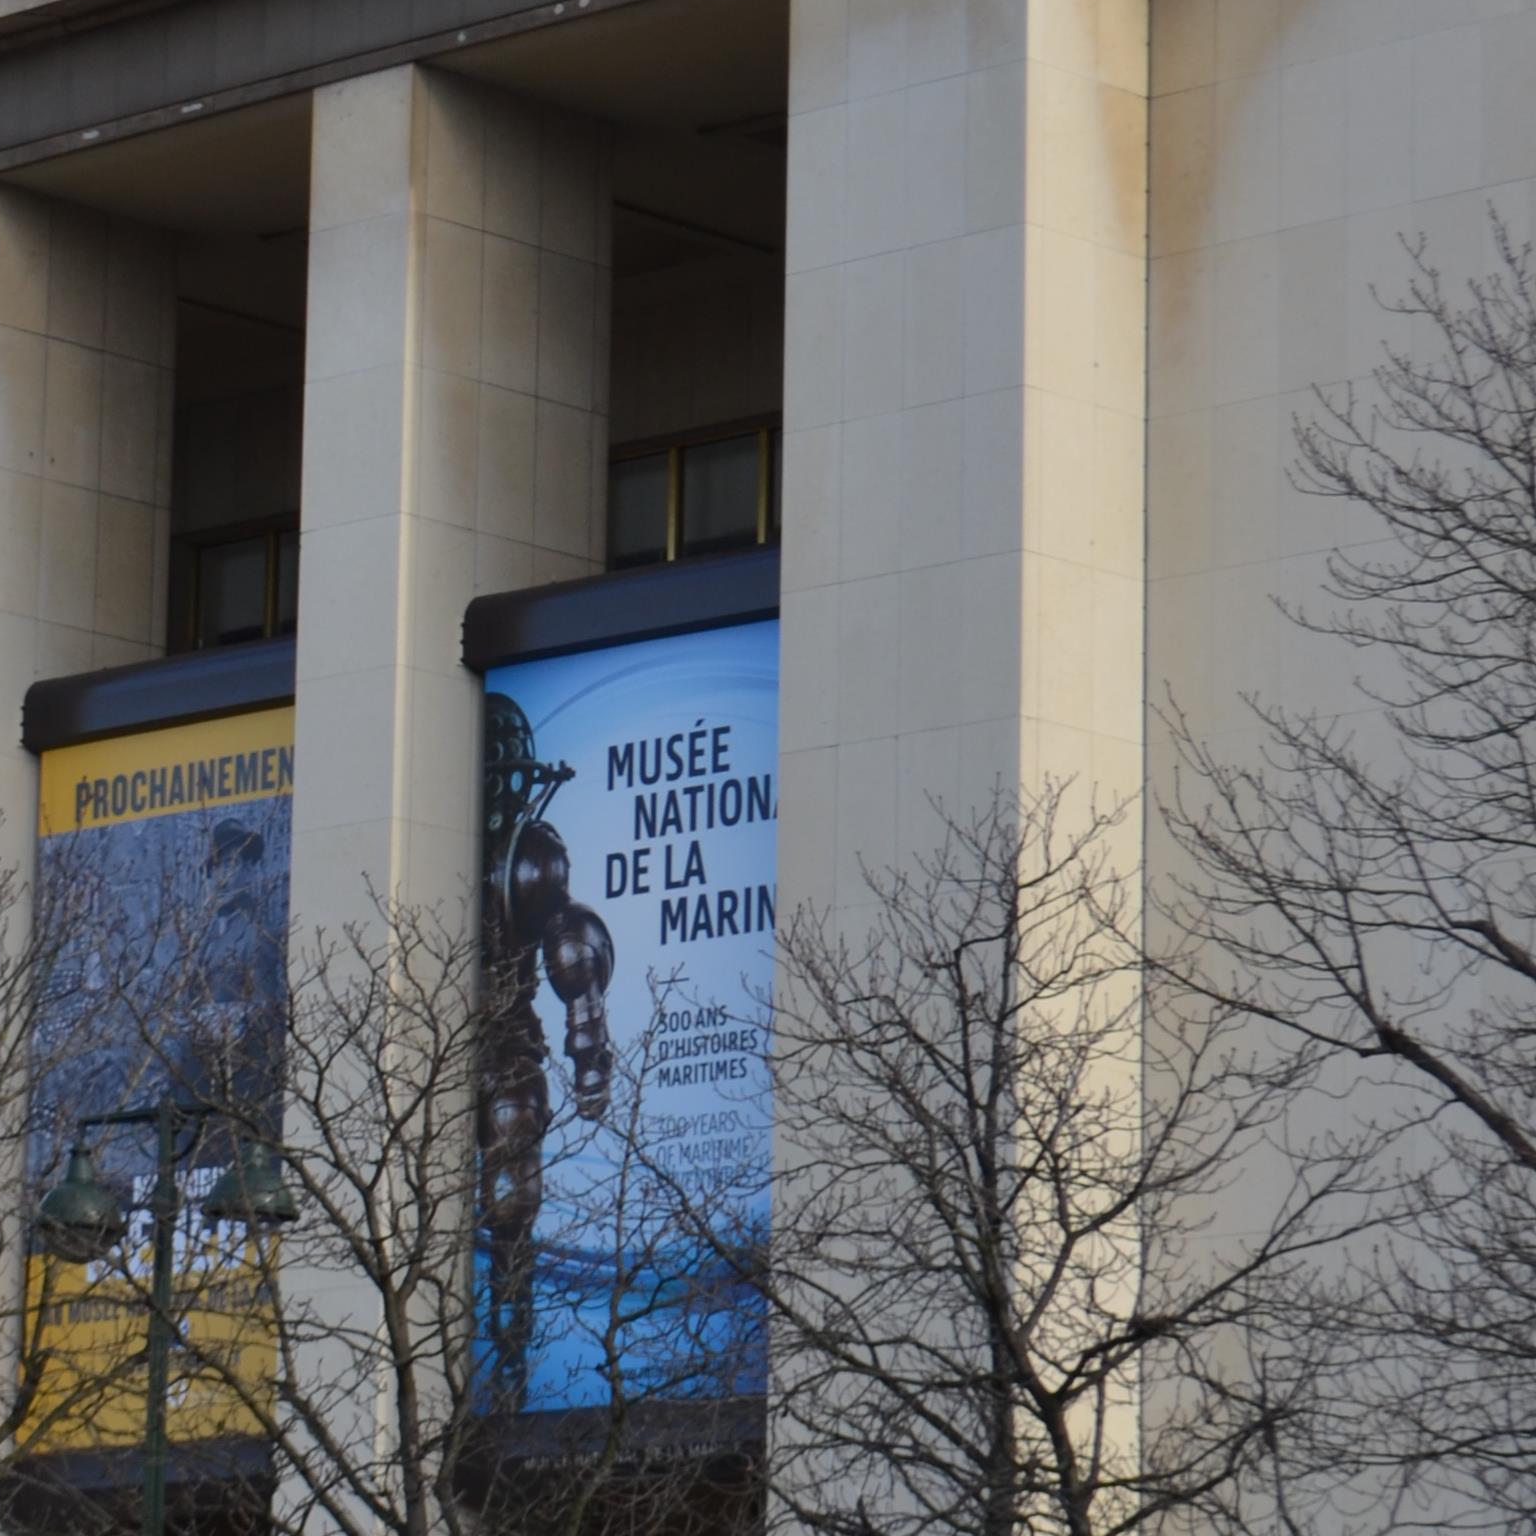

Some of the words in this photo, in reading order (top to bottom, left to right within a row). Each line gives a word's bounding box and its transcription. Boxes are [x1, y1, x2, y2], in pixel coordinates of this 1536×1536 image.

[607, 718, 731, 792] MUSÉE
[633, 773, 778, 841] NATION
[605, 847, 652, 900] DE
[664, 839, 708, 891] LA
[695, 1004, 728, 1029] ANS
[657, 1028, 759, 1062] D'HISTOIRES
[657, 1058, 748, 1089] MARITIMES
